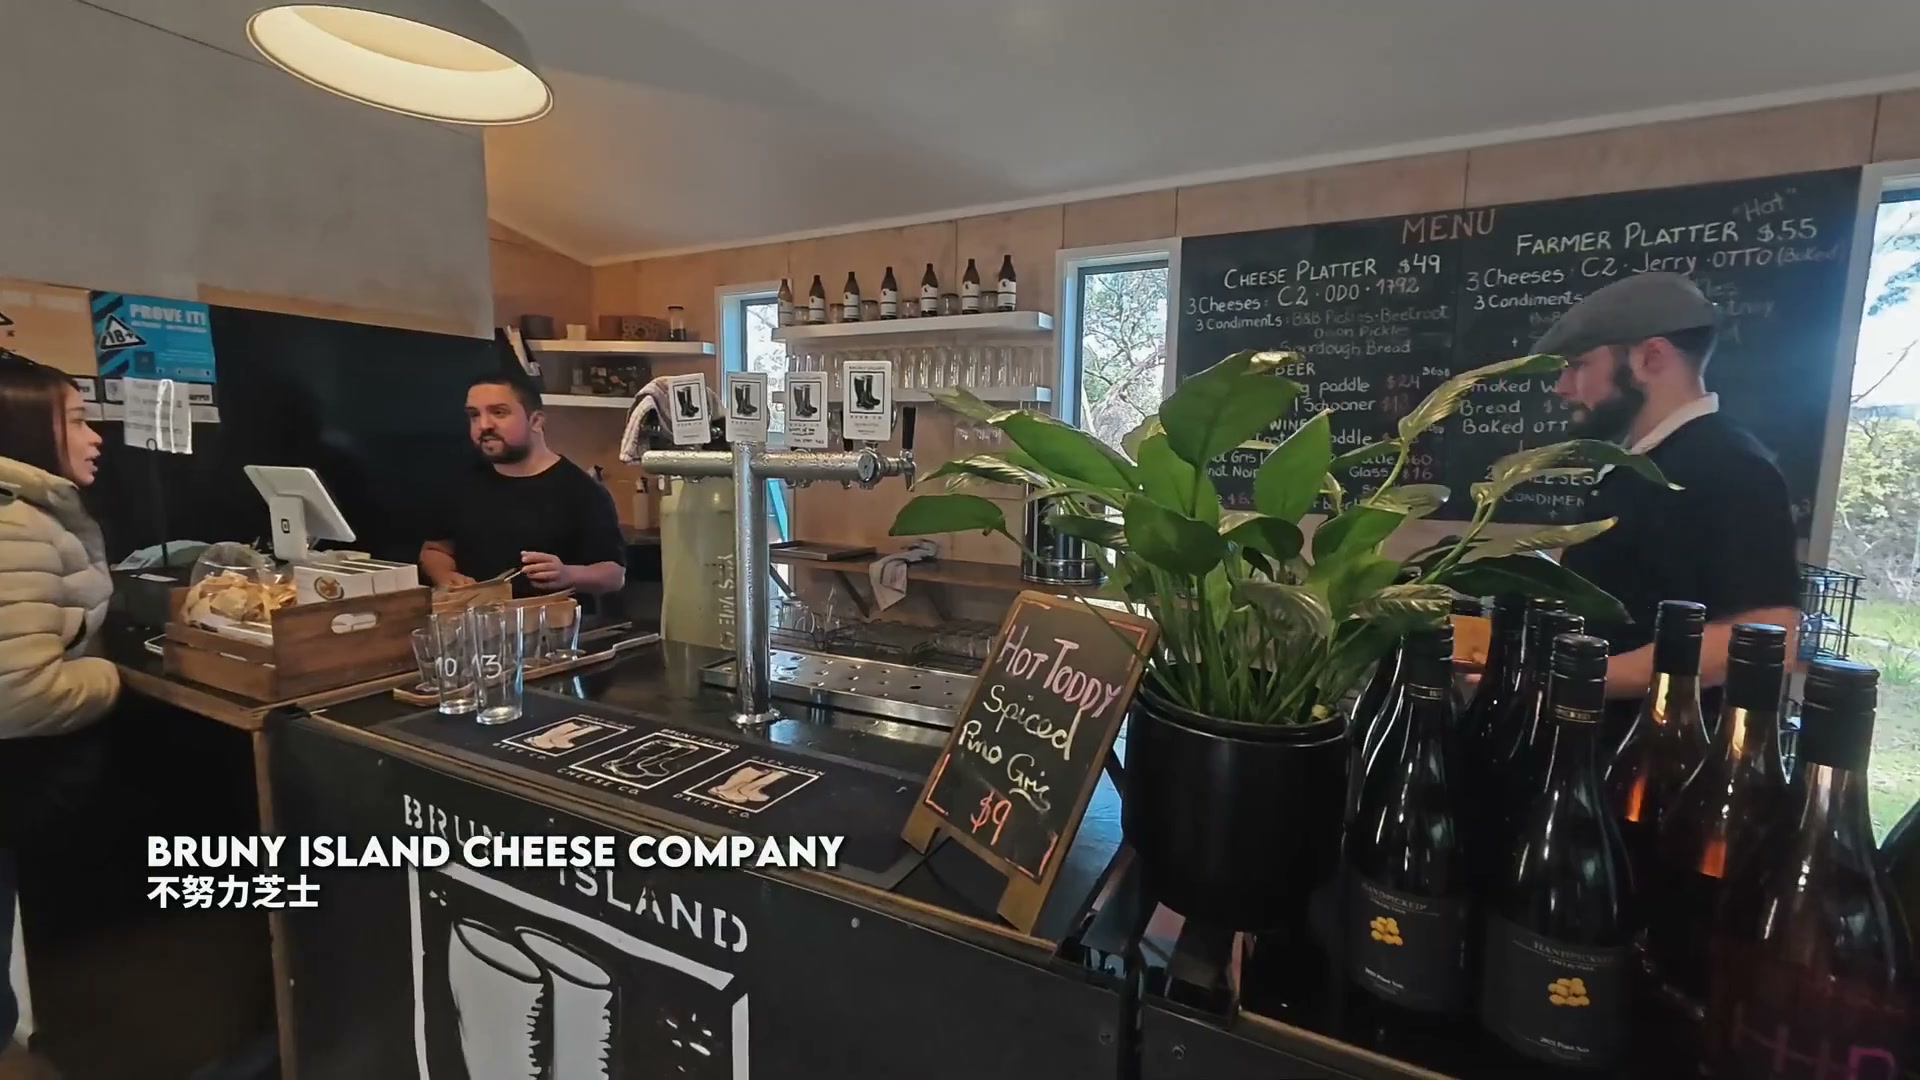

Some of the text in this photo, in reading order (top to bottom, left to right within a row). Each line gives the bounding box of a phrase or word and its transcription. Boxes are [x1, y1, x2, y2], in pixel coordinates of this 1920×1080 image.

[1401, 208, 1496, 245] MENU
[1516, 230, 1612, 257] FARMER
[1624, 220, 1739, 249] PLATTER
[1296, 257, 1377, 281] PLATTER
[1398, 253, 1441, 274] $49
[1581, 256, 1618, 279] C2
[1277, 284, 1309, 307] C2
[1375, 276, 1419, 295] 1792
[129, 303, 183, 321] PROVE
[1319, 376, 1371, 397] paddle
[1459, 399, 1521, 417] Bread
[1462, 417, 1525, 435] Baked
[1348, 465, 1389, 479] Glass
[982, 684, 1083, 761] Spiced
[556, 767, 613, 787] CHEESE
[672, 793, 722, 809] DAIRY
[970, 790, 1012, 846] $9
